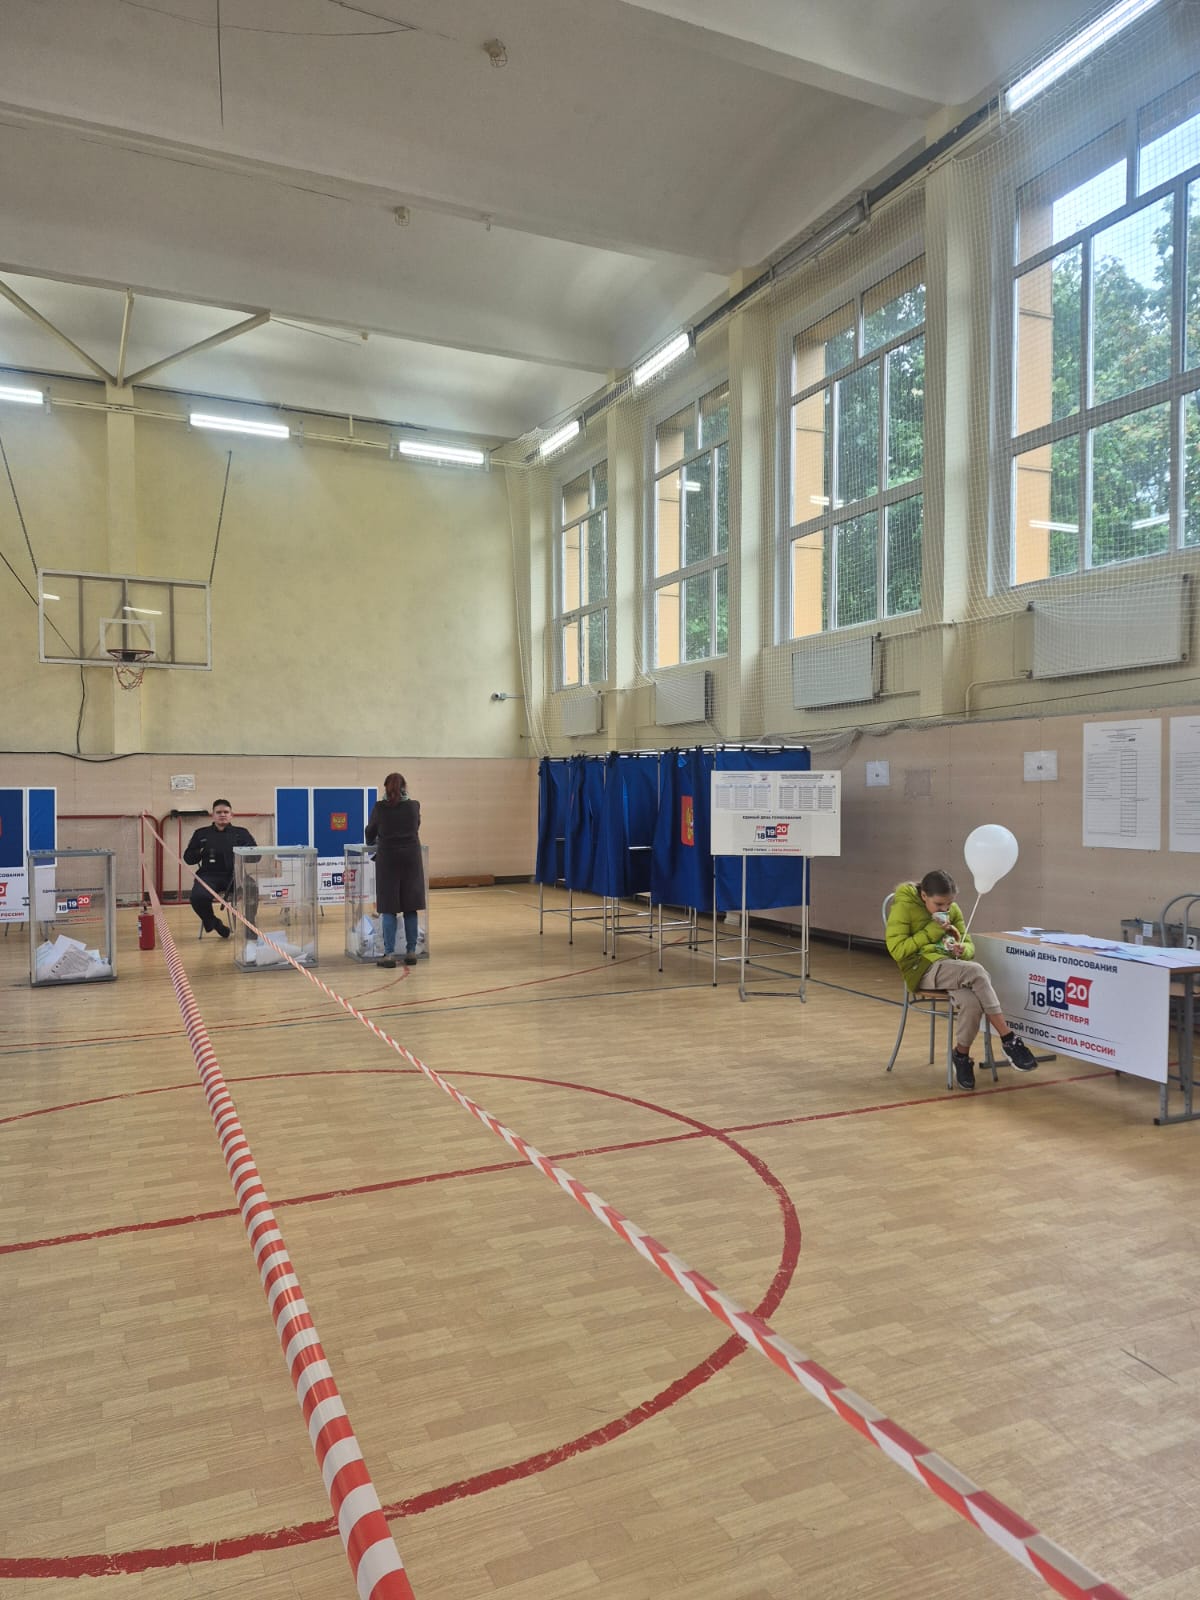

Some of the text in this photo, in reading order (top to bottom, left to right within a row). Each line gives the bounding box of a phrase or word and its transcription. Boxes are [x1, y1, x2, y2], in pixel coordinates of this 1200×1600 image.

[776, 825, 787, 833] 20
[333, 875, 342, 883] 19
[68, 900, 77, 908] 19
[1006, 946, 1118, 973] ЕДИНЫЙ ДЕНЬ ГОЛОСОВАНИЯ
[1030, 982, 1087, 1007] 18 19 20
[1050, 1009, 1089, 1025] СЕНТЯБРЯ
[1005, 1020, 1024, 1032] ТВОЙ
[1025, 1026, 1050, 1038] ГОЛОС
[1057, 1034, 1078, 1046] СИЛА
[1080, 1042, 1116, 1056] РОССИИ!
